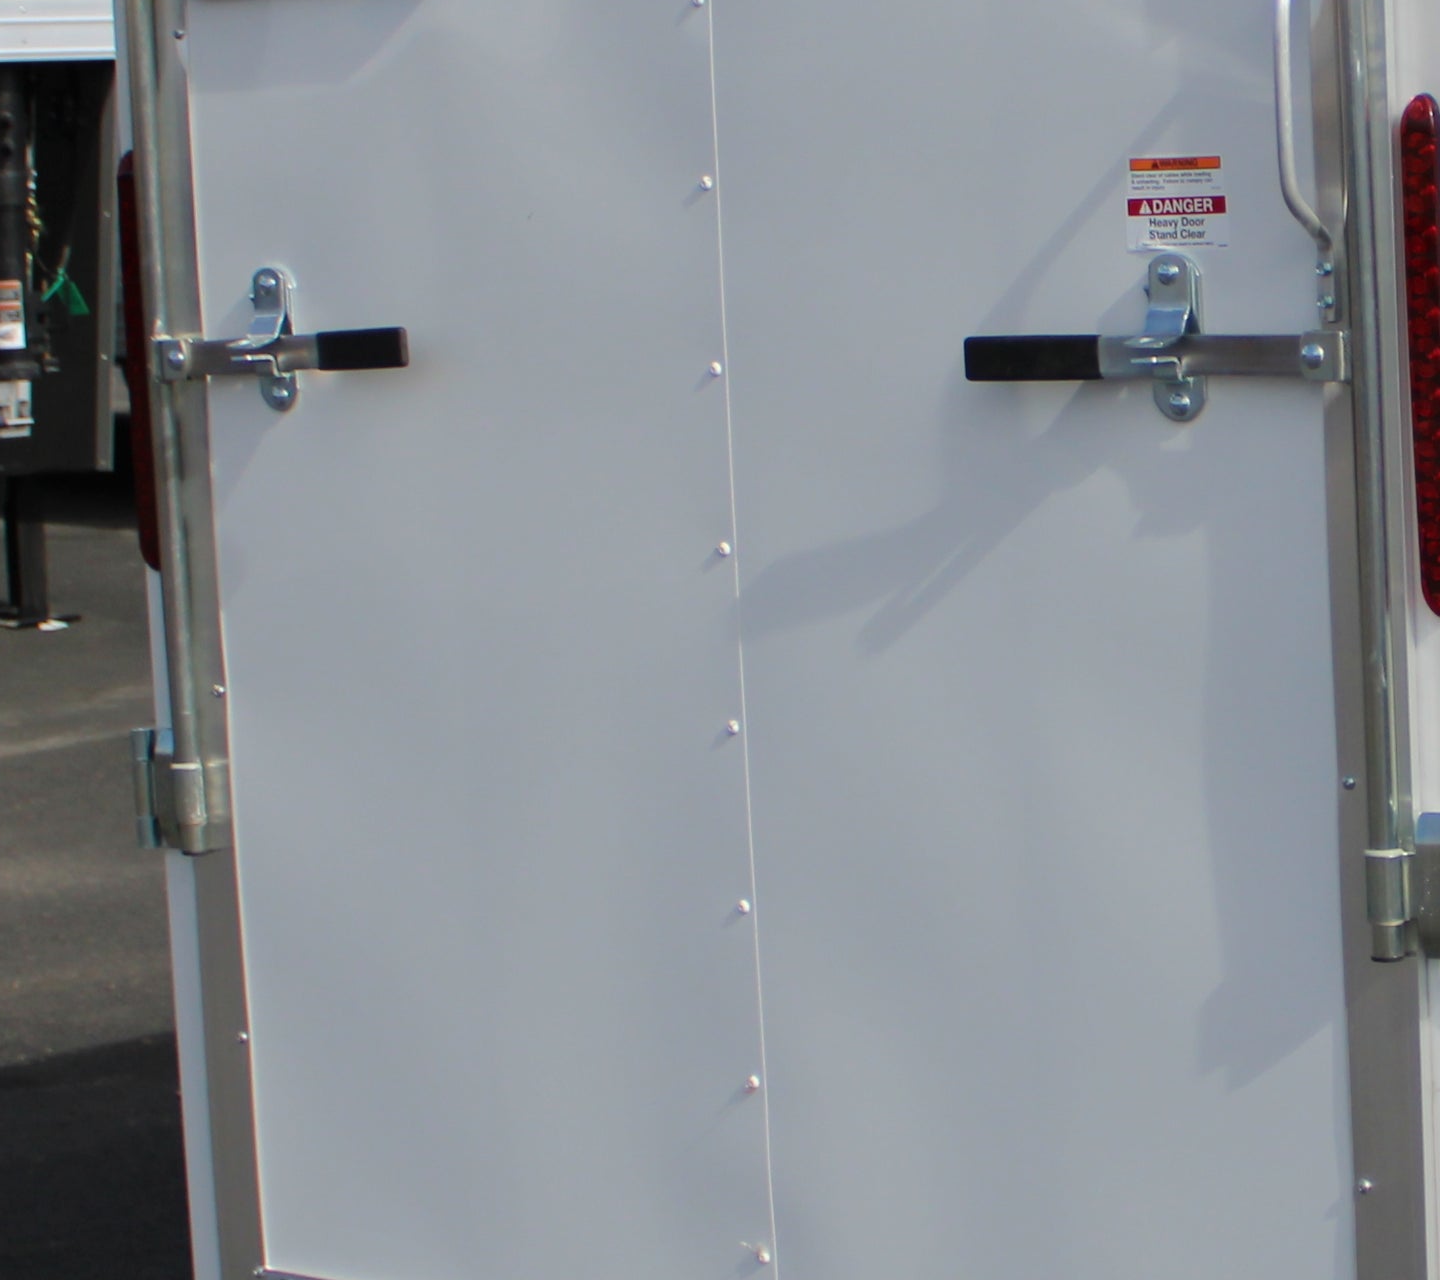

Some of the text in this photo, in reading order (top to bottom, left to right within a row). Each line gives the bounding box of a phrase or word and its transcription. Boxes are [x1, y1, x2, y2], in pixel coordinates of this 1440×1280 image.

[1152, 198, 1214, 214] DANGER
[1149, 216, 1206, 229] Heavy Door
[1149, 228, 1206, 240] Stand Clear
